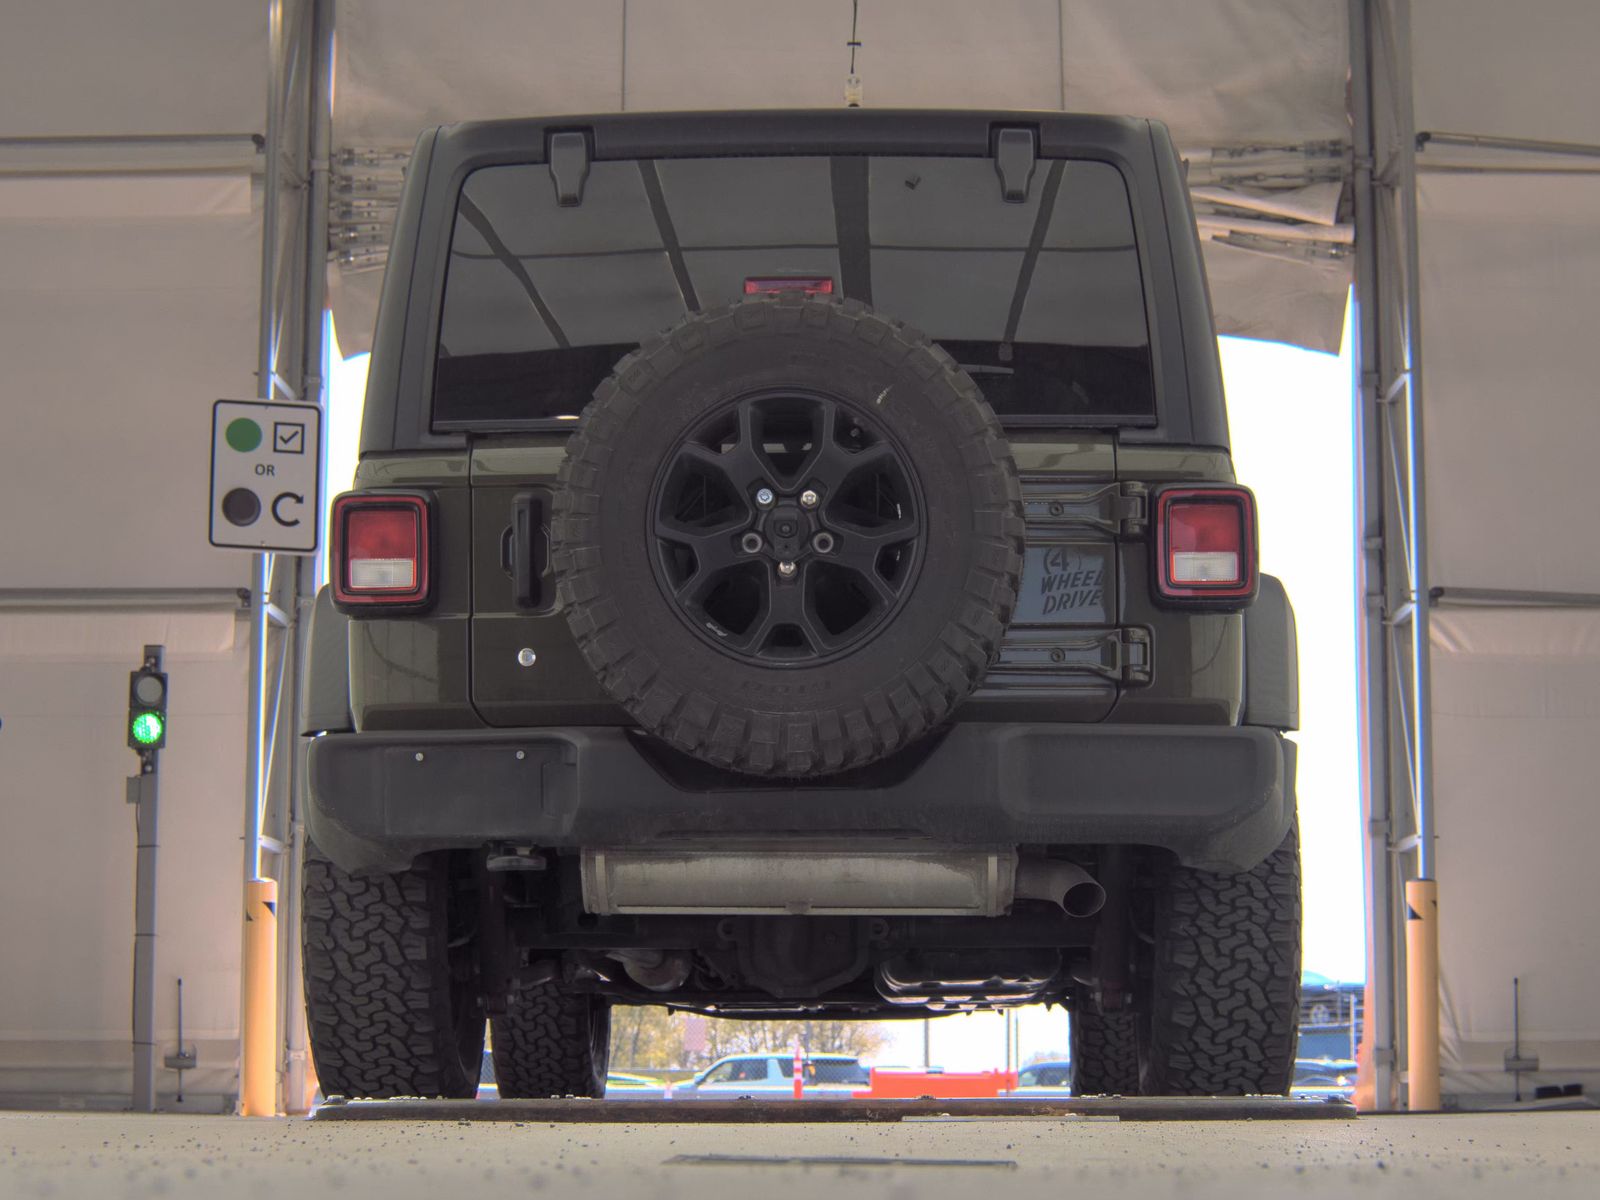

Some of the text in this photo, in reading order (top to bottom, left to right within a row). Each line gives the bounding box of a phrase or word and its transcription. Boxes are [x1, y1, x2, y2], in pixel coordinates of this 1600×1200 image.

[254, 463, 276, 477] OR
[1041, 570, 1104, 596] WHEEL
[1042, 590, 1103, 615] DRIVE
